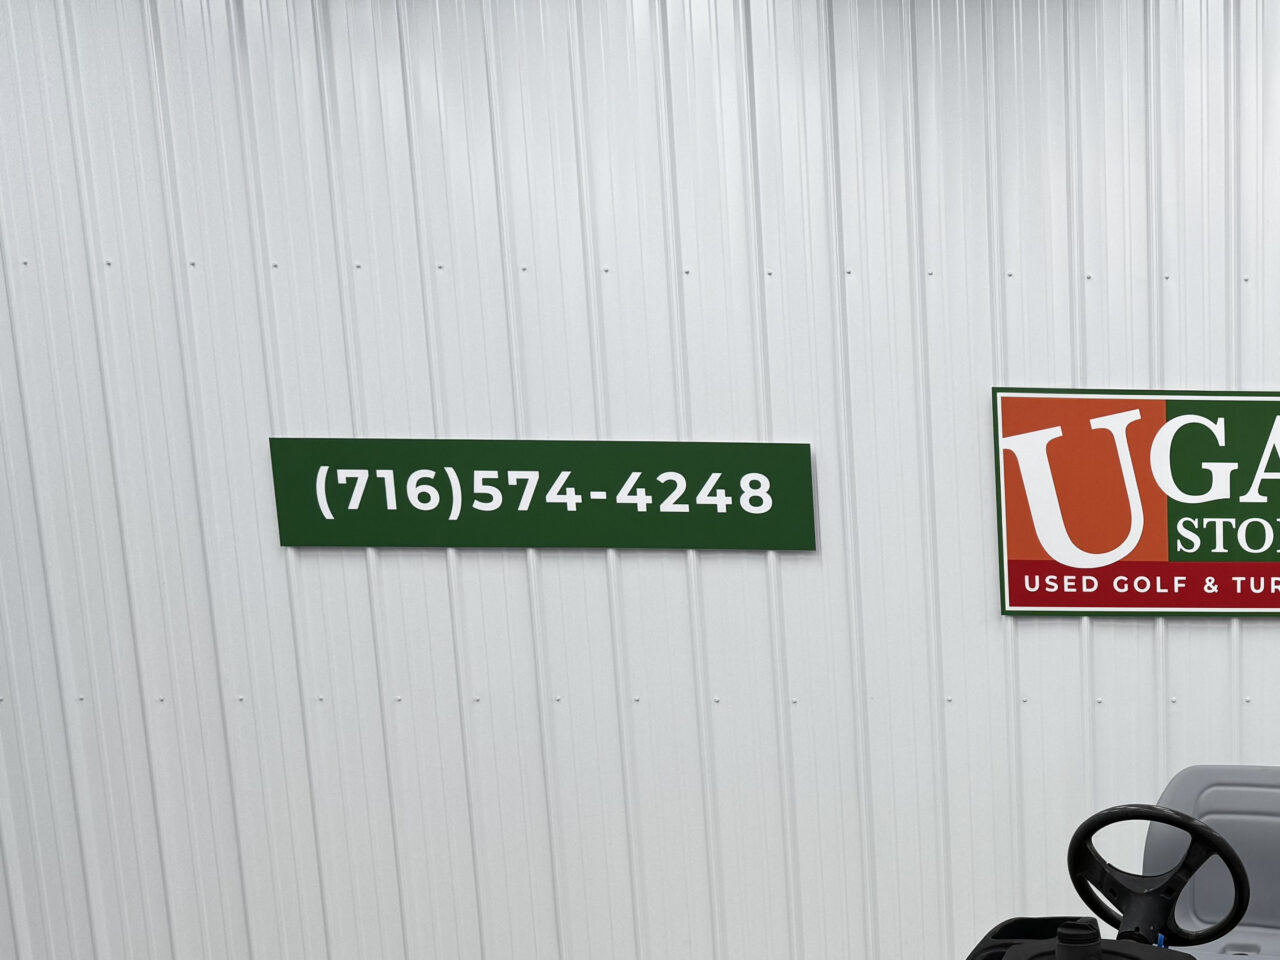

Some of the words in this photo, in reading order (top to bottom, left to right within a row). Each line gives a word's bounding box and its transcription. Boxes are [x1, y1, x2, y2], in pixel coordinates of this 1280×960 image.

[315, 465, 774, 521] (716)574-4248
[1024, 574, 1099, 593] USED
[1112, 575, 1187, 593] GOLF
[1203, 576, 1219, 594] &
